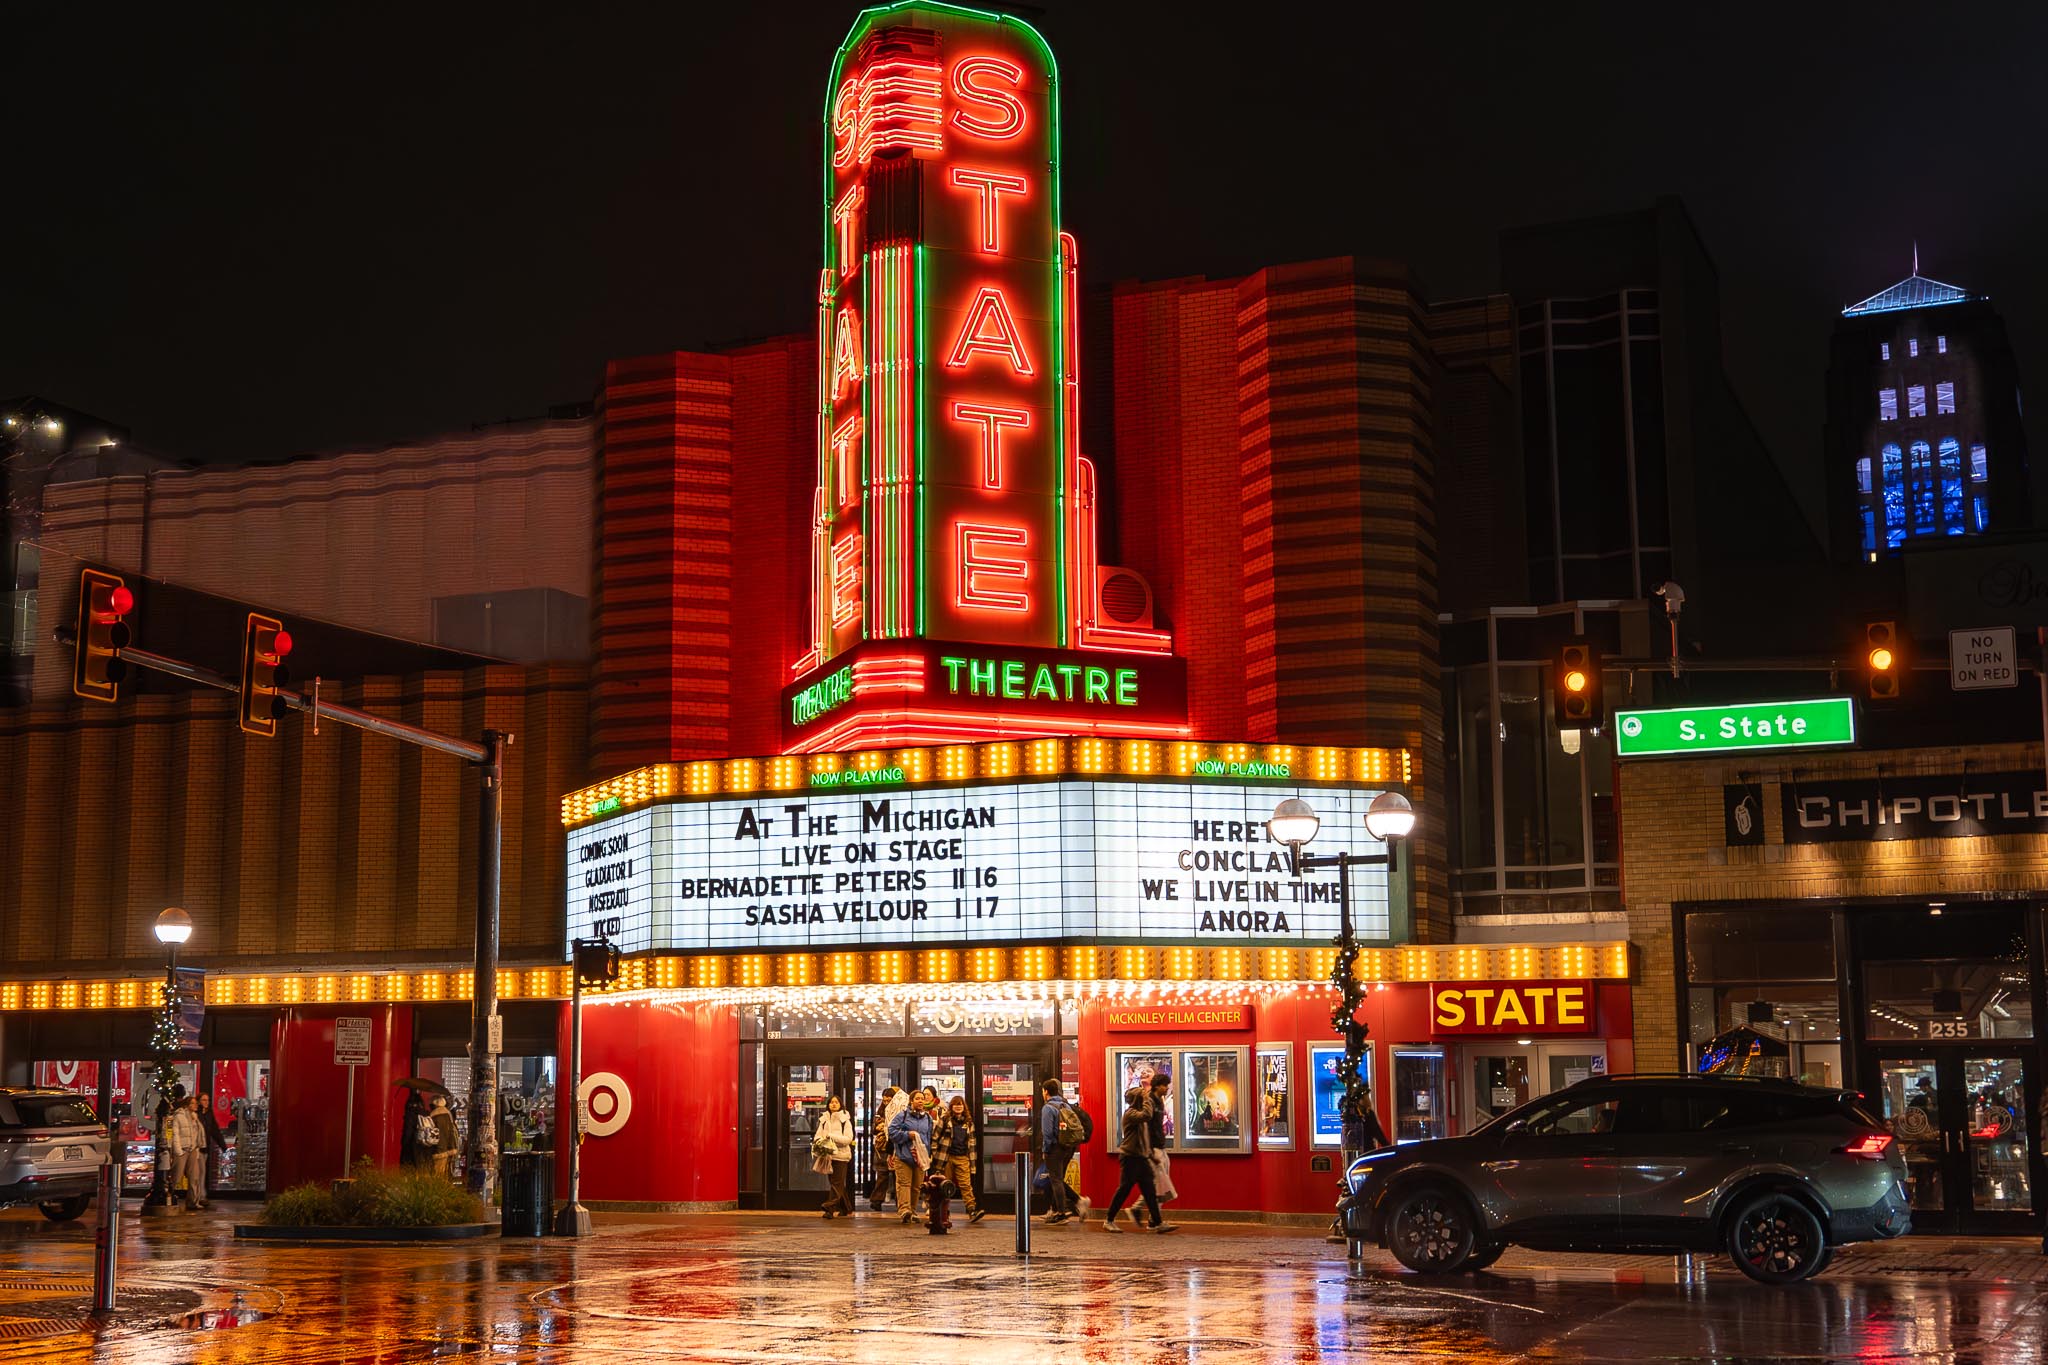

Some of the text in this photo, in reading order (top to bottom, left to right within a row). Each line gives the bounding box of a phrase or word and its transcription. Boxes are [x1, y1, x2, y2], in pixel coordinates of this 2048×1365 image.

[946, 56, 1034, 613] STATE
[1971, 636, 1994, 649] NO
[1965, 652, 2002, 665] TURN
[941, 656, 1139, 706] THEATRE
[1958, 667, 2010, 682] ON RED
[792, 665, 852, 726] THEATRE
[1679, 714, 1807, 741] S. State
[811, 767, 904, 785] NOW PLAYING
[1195, 760, 1290, 777] NOW PLAYING
[1799, 791, 2048, 829] CHIPOTLE
[1193, 819, 1272, 844] HERET
[580, 832, 629, 864] COMING SOON
[781, 838, 963, 867] LIVE ON STAGE
[585, 861, 626, 888] GLADIATOR
[681, 873, 824, 899] BERNADETTE
[835, 869, 927, 894] PETERS
[588, 887, 629, 914] NOSFERATU
[1142, 878, 1341, 903] WE LIVE IN TIME
[745, 903, 825, 926] SASHA
[833, 899, 928, 923] VELOUR
[1200, 910, 1290, 933] ANORA
[593, 917, 621, 938] WICKED
[1109, 1011, 1241, 1025] MCKINLEY FILM CENTER
[1436, 987, 1585, 1027] STATE
[962, 1007, 1032, 1033] target
[1931, 1022, 1969, 1038] 235
[1266, 1064, 1286, 1074] LIVE
[1270, 1055, 1286, 1065] WE
[1265, 1081, 1287, 1092] TIME
[1277, 1073, 1287, 1082] IN
[84, 1085, 126, 1098] Excges
